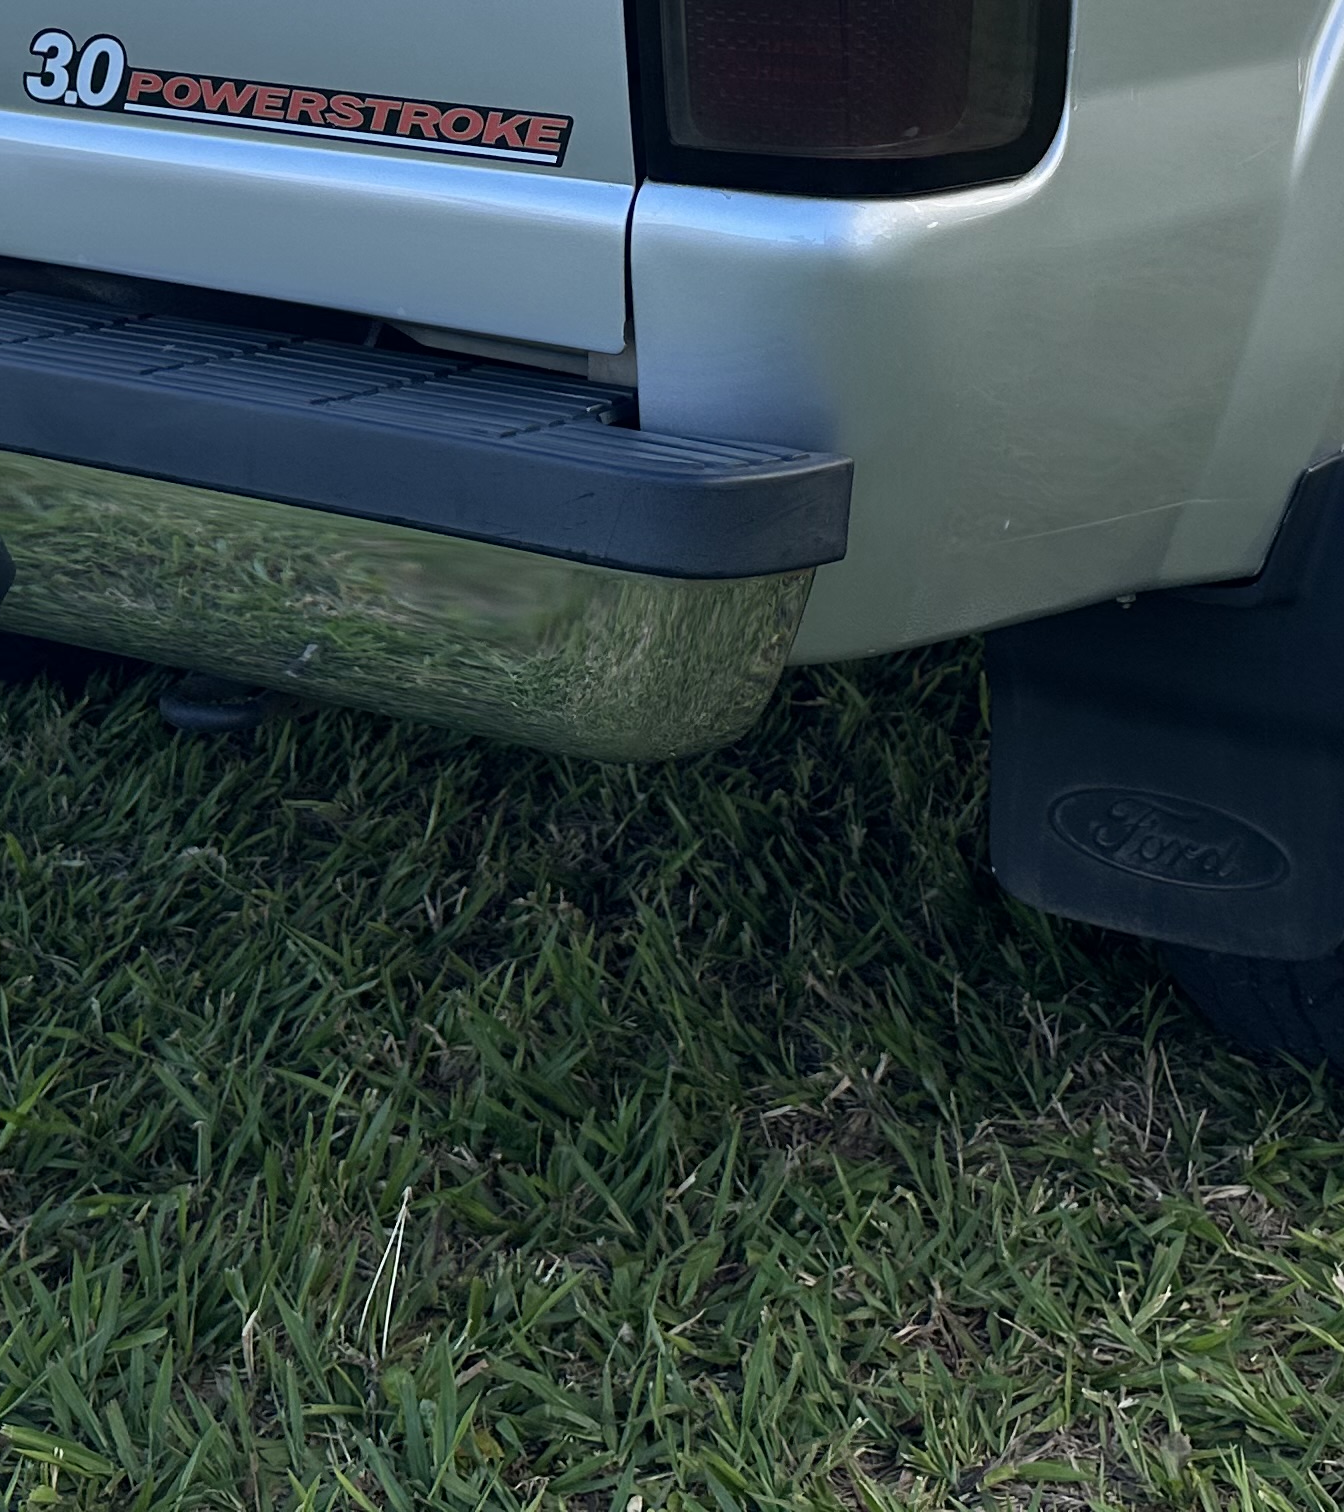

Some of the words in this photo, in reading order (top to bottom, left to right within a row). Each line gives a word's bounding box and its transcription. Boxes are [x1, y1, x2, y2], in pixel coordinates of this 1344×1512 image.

[24, 29, 126, 107] 3.0
[125, 71, 570, 152] POWERSTROKE
[1089, 794, 1242, 878] Ford
